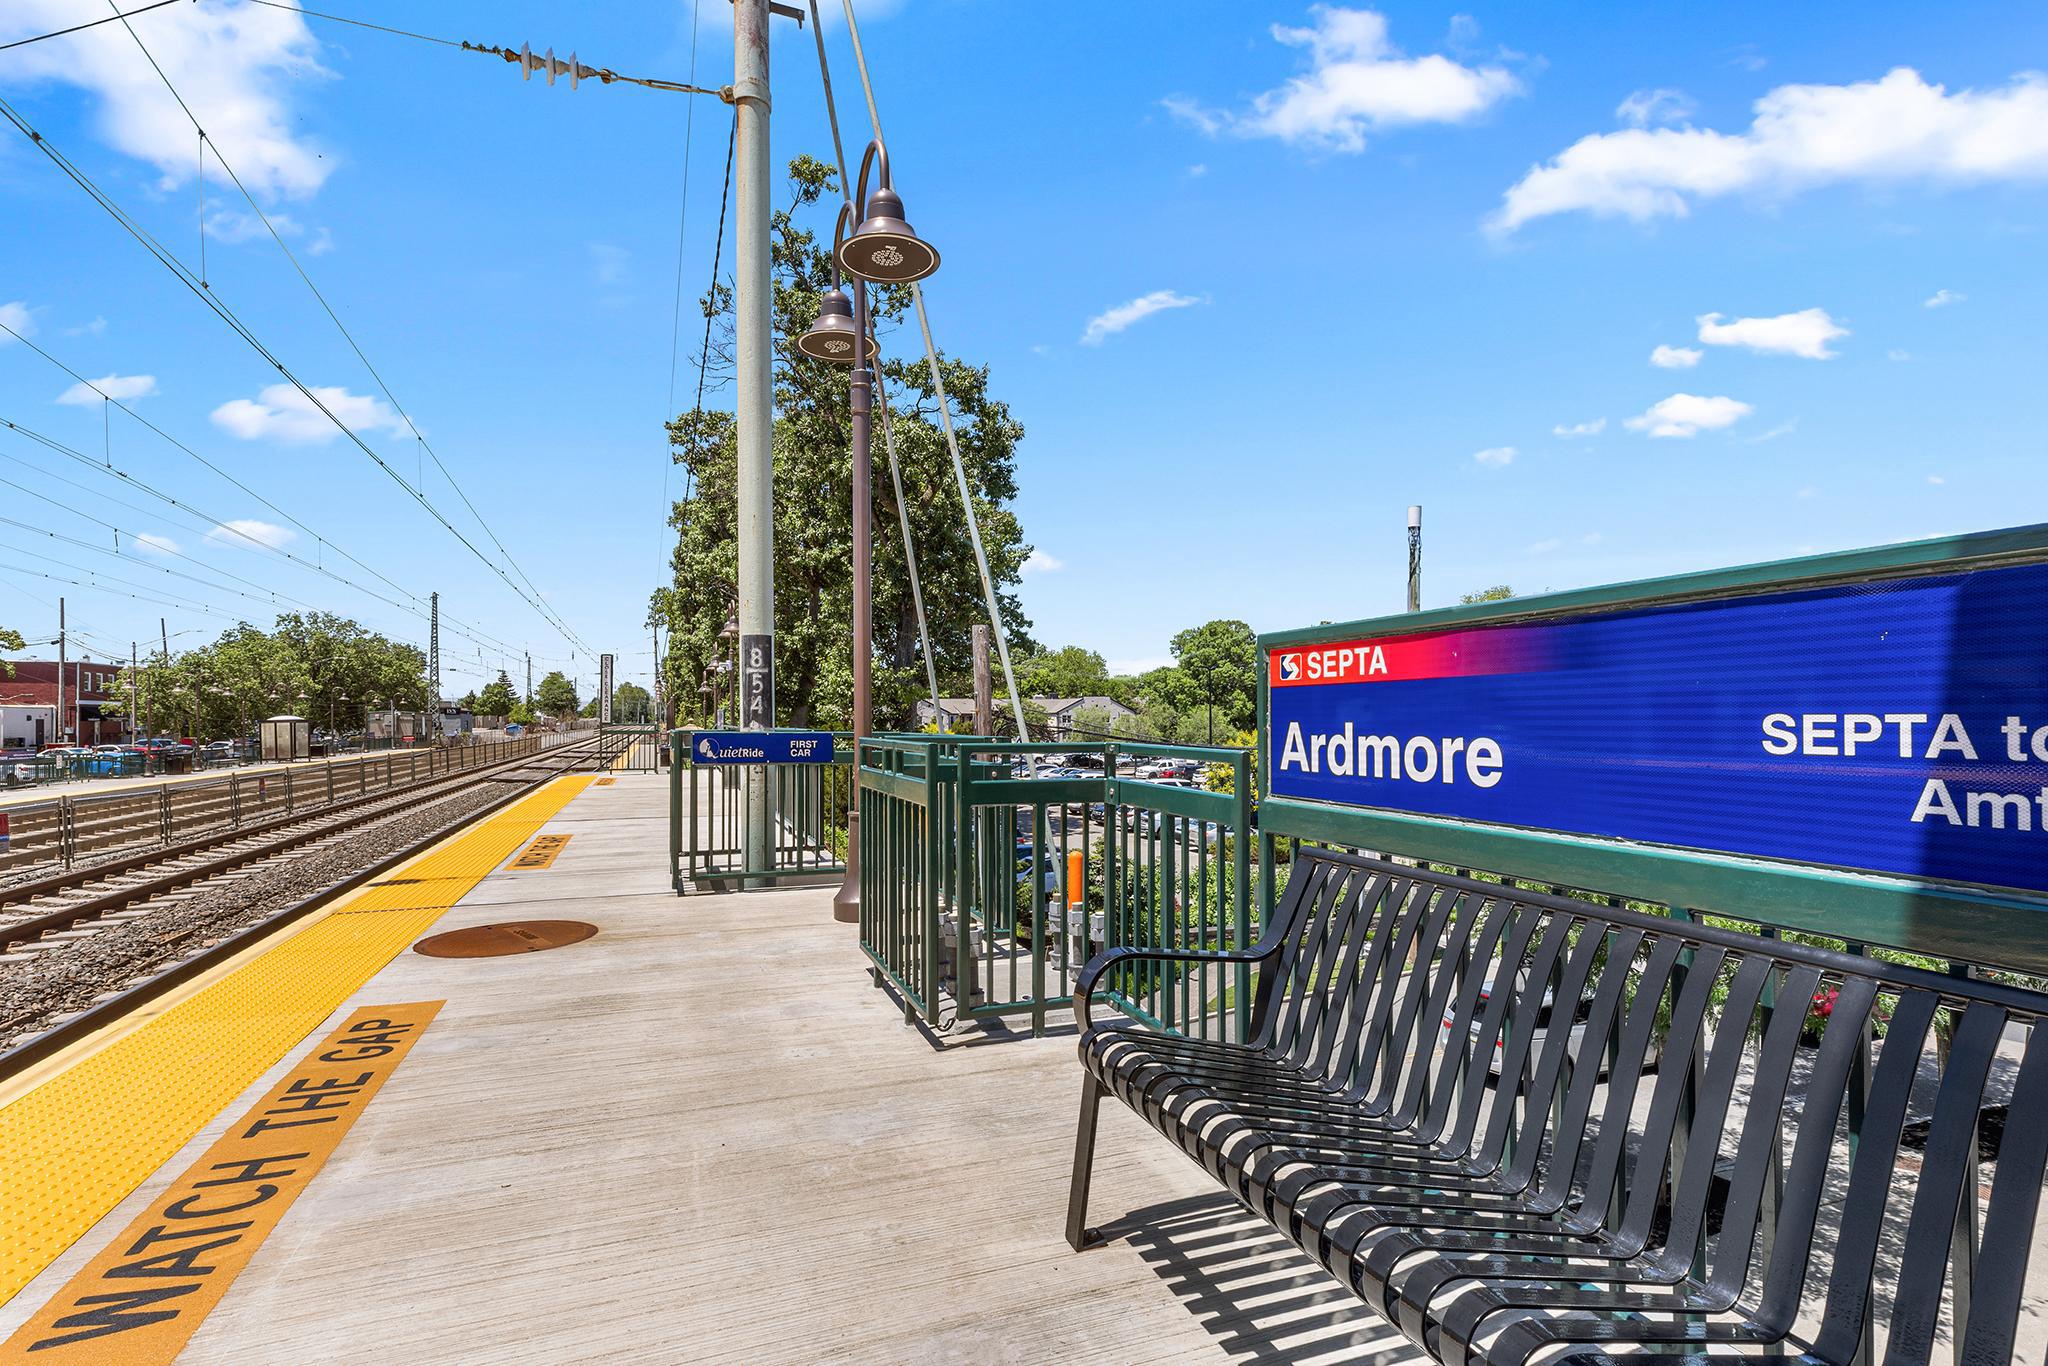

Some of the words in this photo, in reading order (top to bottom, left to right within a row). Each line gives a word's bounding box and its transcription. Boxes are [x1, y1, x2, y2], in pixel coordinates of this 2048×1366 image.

[1307, 646, 1388, 680] SEPTA
[790, 740, 818, 749] FIRST
[790, 749, 811, 757] CAR
[1280, 721, 1504, 788] Ardmore
[1761, 713, 1979, 760] SEPTA
[27, 1152, 310, 1352] WATCH
[242, 1071, 375, 1139] THE
[319, 1018, 415, 1062] GAP
